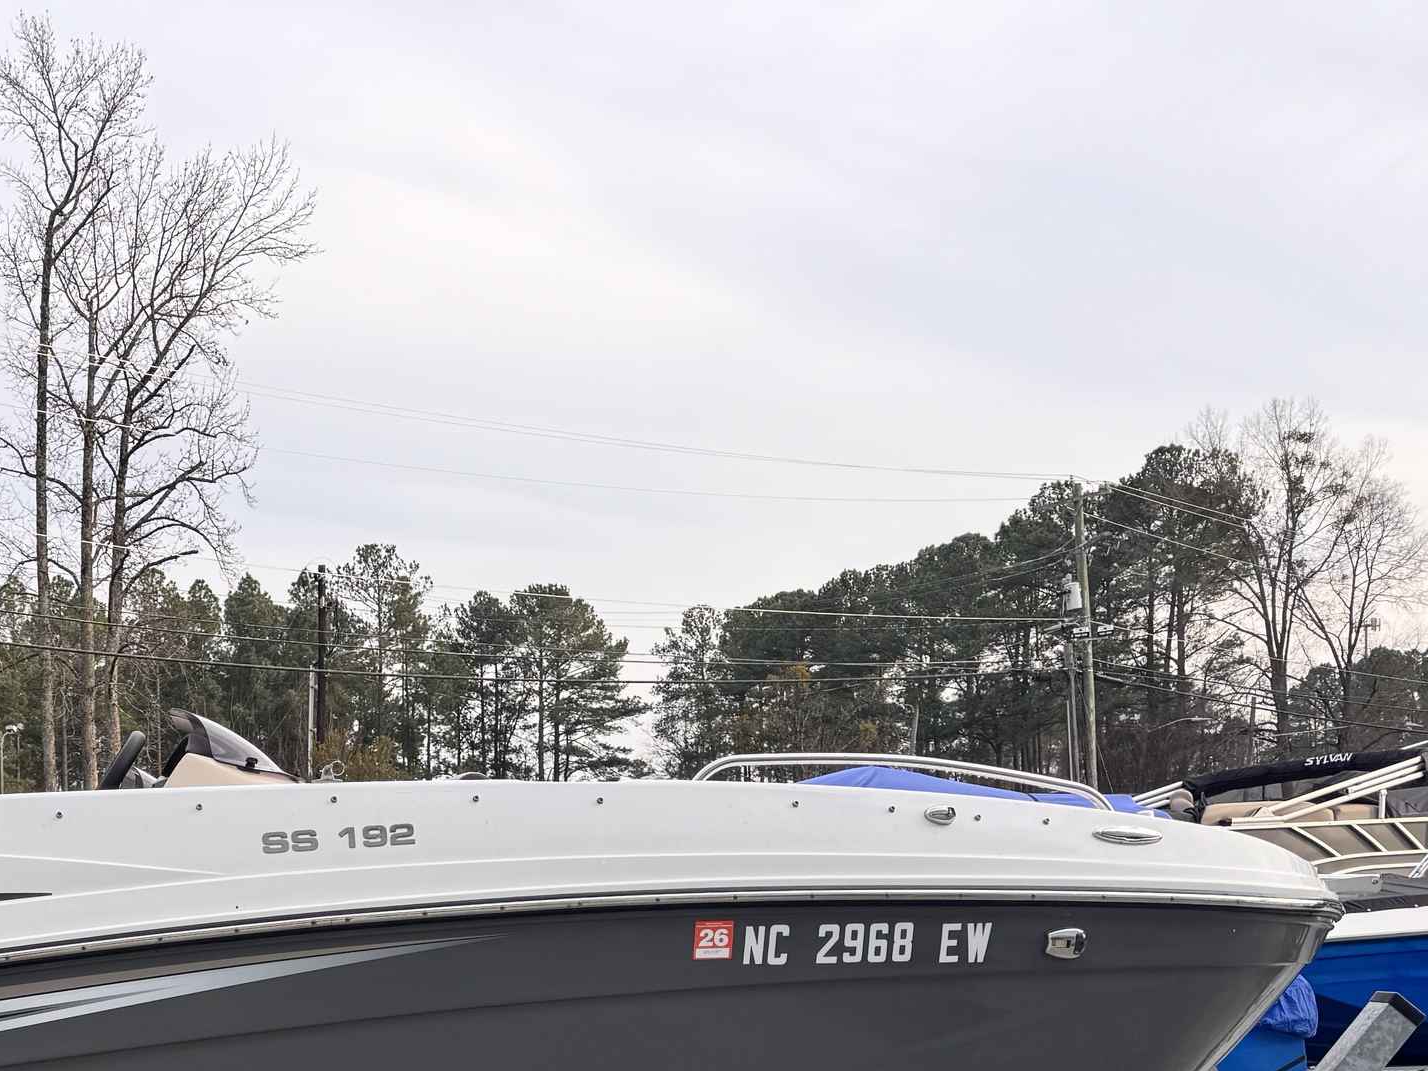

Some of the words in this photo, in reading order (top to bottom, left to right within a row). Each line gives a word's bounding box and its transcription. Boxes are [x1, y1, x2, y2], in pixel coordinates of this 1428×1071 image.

[1304, 752, 1353, 766] SYLVAN
[261, 829, 319, 854] SS
[338, 823, 416, 849] 192
[699, 928, 729, 947] 26
[743, 925, 790, 965] NC
[816, 922, 914, 964] 2968
[939, 922, 992, 963] EW
